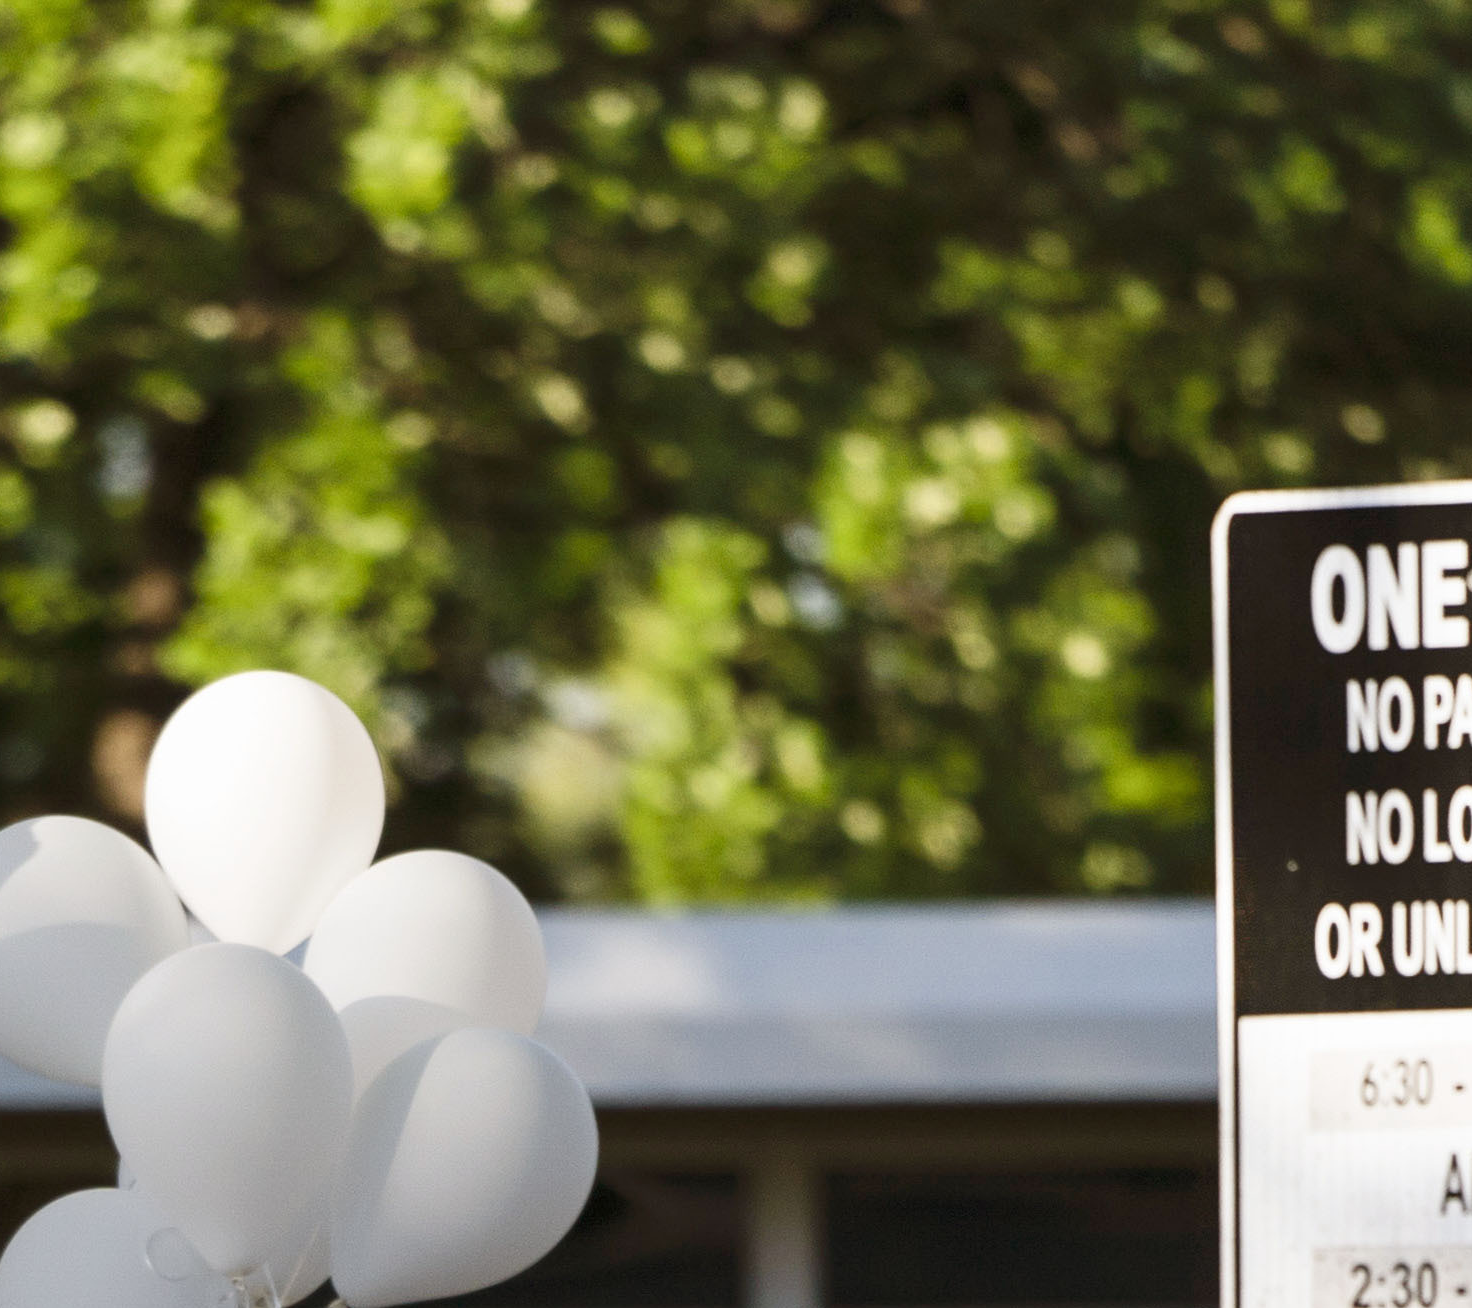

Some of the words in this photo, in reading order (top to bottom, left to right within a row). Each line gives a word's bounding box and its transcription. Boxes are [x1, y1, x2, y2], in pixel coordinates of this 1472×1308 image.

[1311, 539, 1469, 653] ONE
[1346, 676, 1414, 753] NO
[1346, 788, 1414, 866] NO
[1314, 902, 1384, 979] OR
[1360, 1058, 1434, 1107] 6:30
